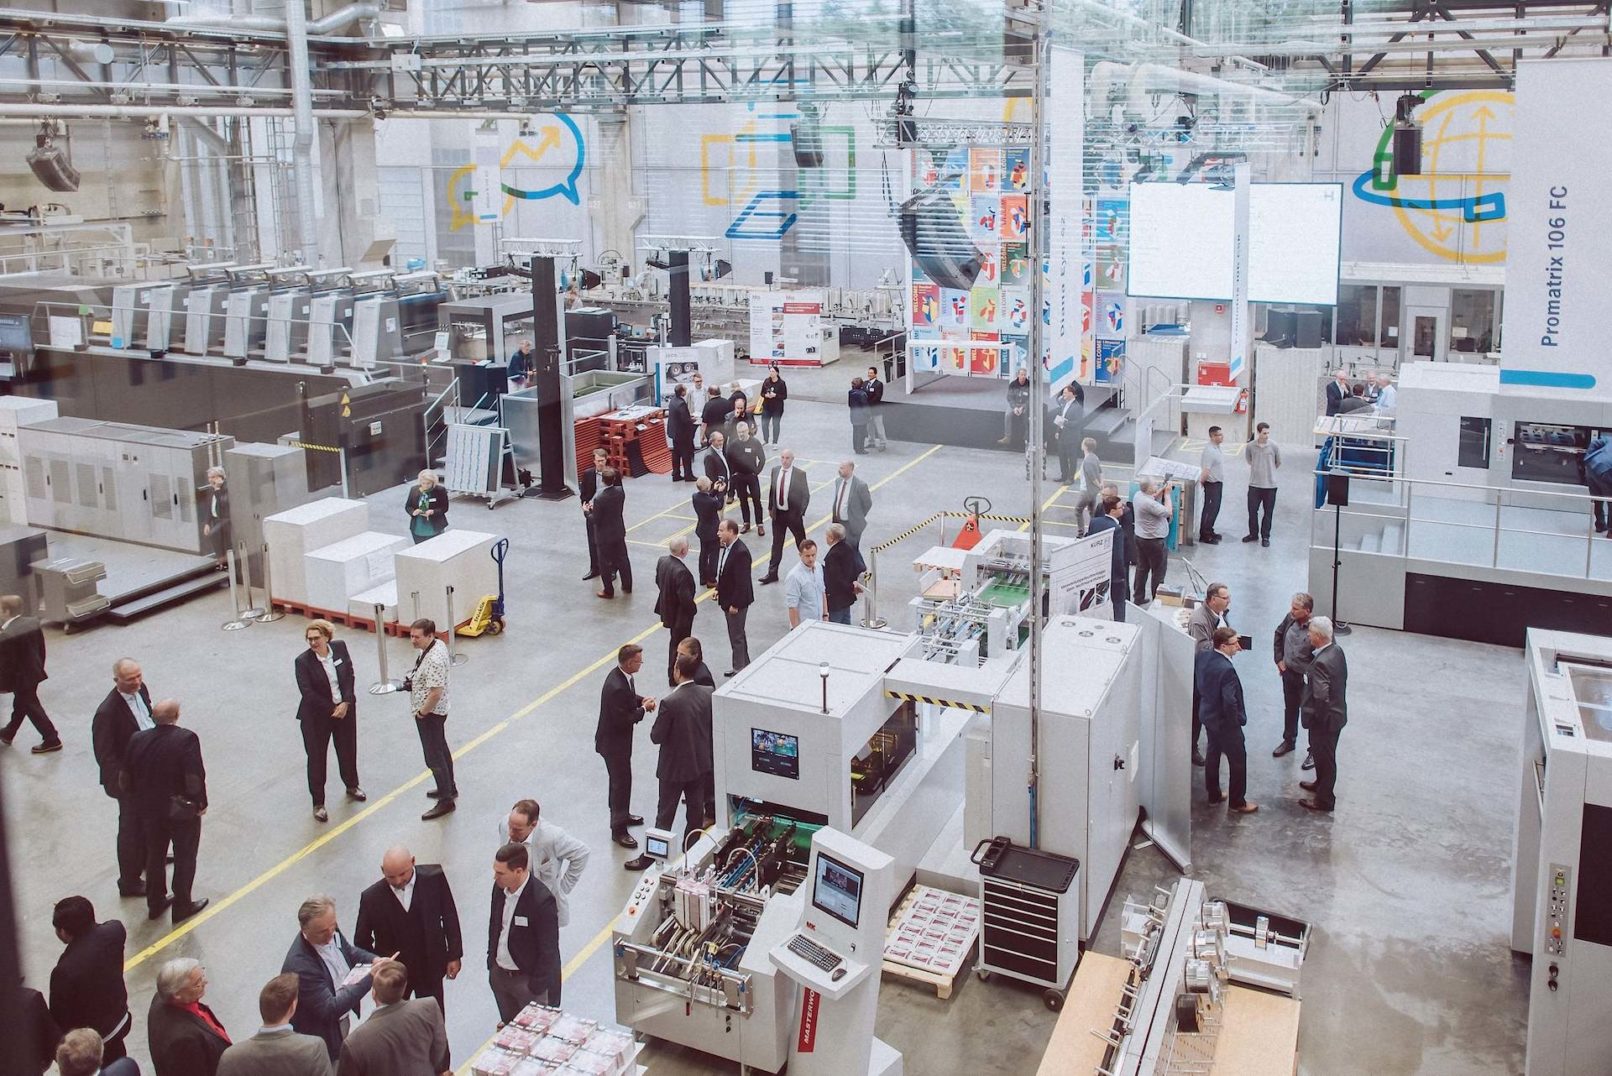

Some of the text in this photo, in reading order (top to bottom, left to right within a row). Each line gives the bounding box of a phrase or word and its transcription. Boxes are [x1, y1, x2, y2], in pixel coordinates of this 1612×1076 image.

[1541, 186, 1568, 347] Promatrix 106 FC
